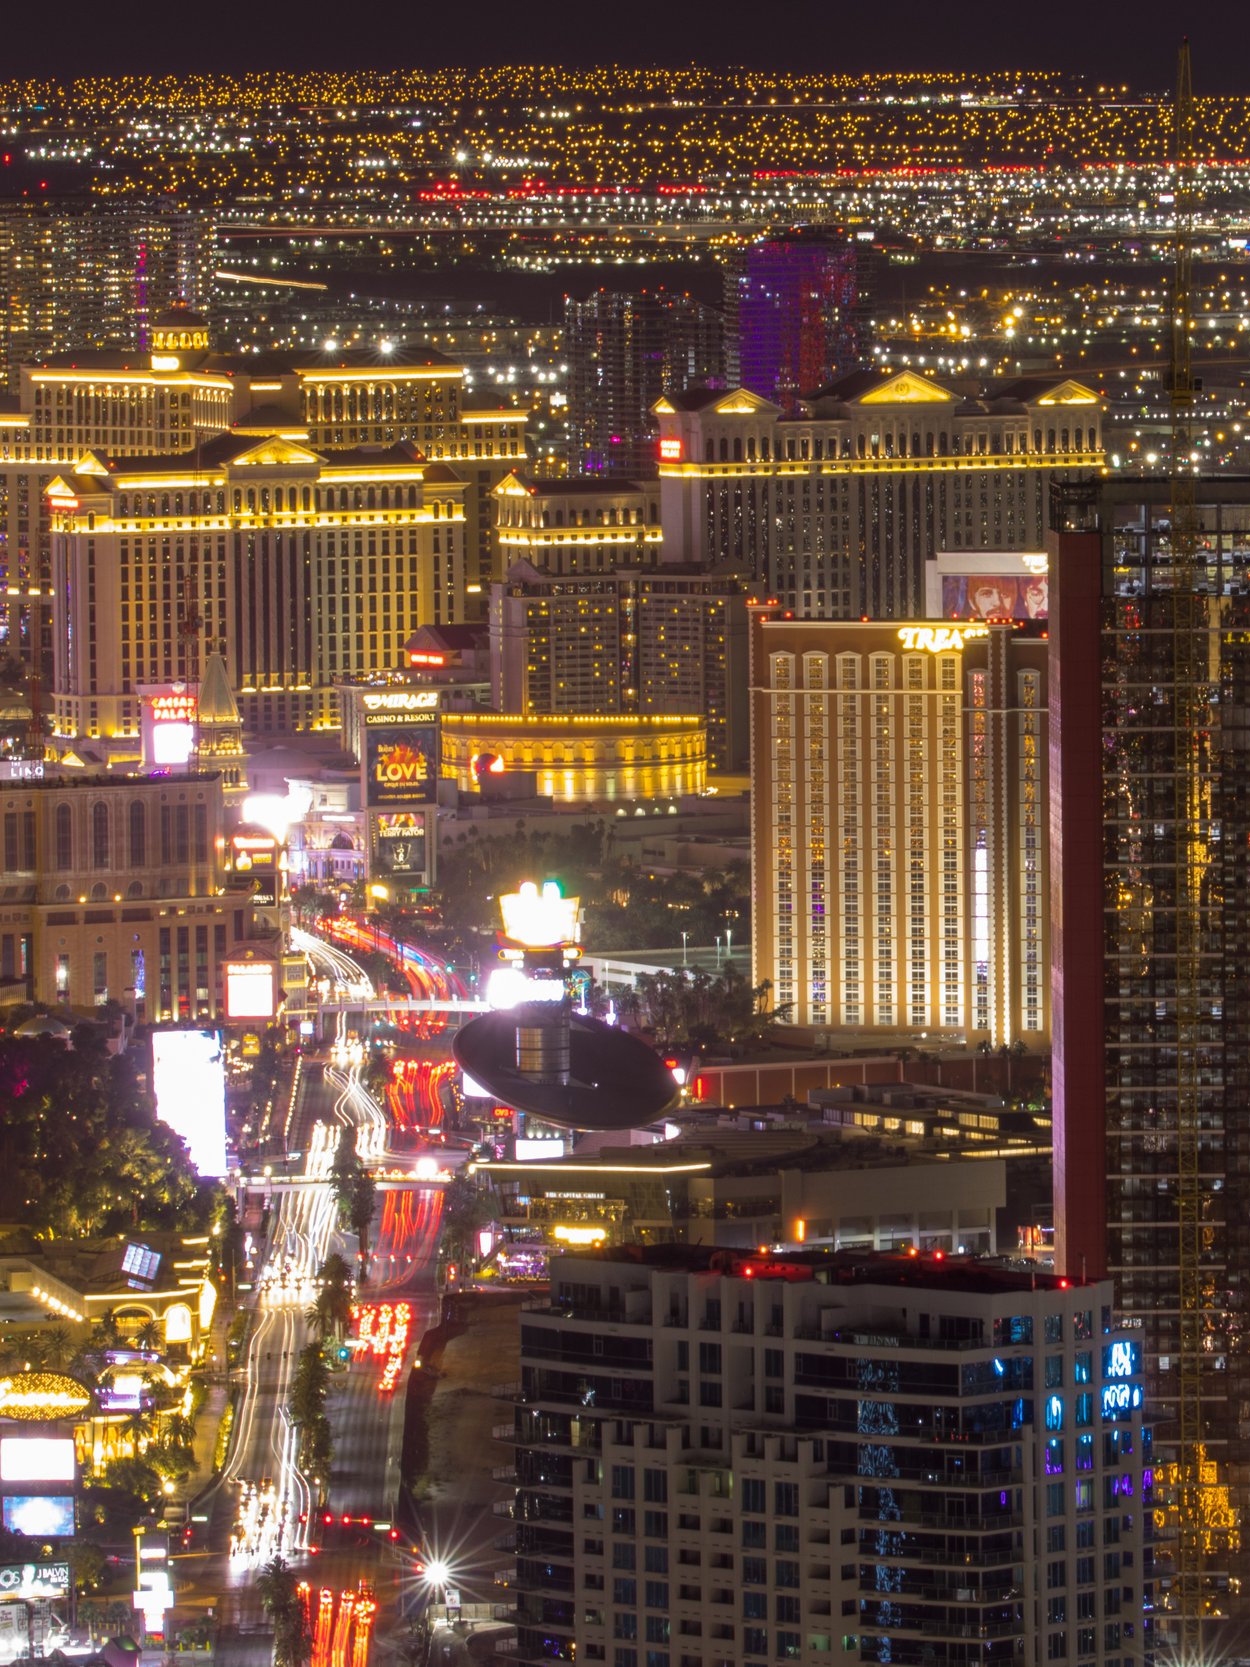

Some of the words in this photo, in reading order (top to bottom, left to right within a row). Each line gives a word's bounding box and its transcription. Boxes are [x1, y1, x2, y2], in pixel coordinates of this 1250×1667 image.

[380, 692, 438, 709] MIRAGE
[366, 715, 396, 723] CASINO
[404, 714, 435, 722] RESORT
[11, 766, 43, 777] LINQ
[377, 762, 427, 781] LOVE
[379, 829, 401, 837] TERRY
[43, 1567, 68, 1578] BALVIN
